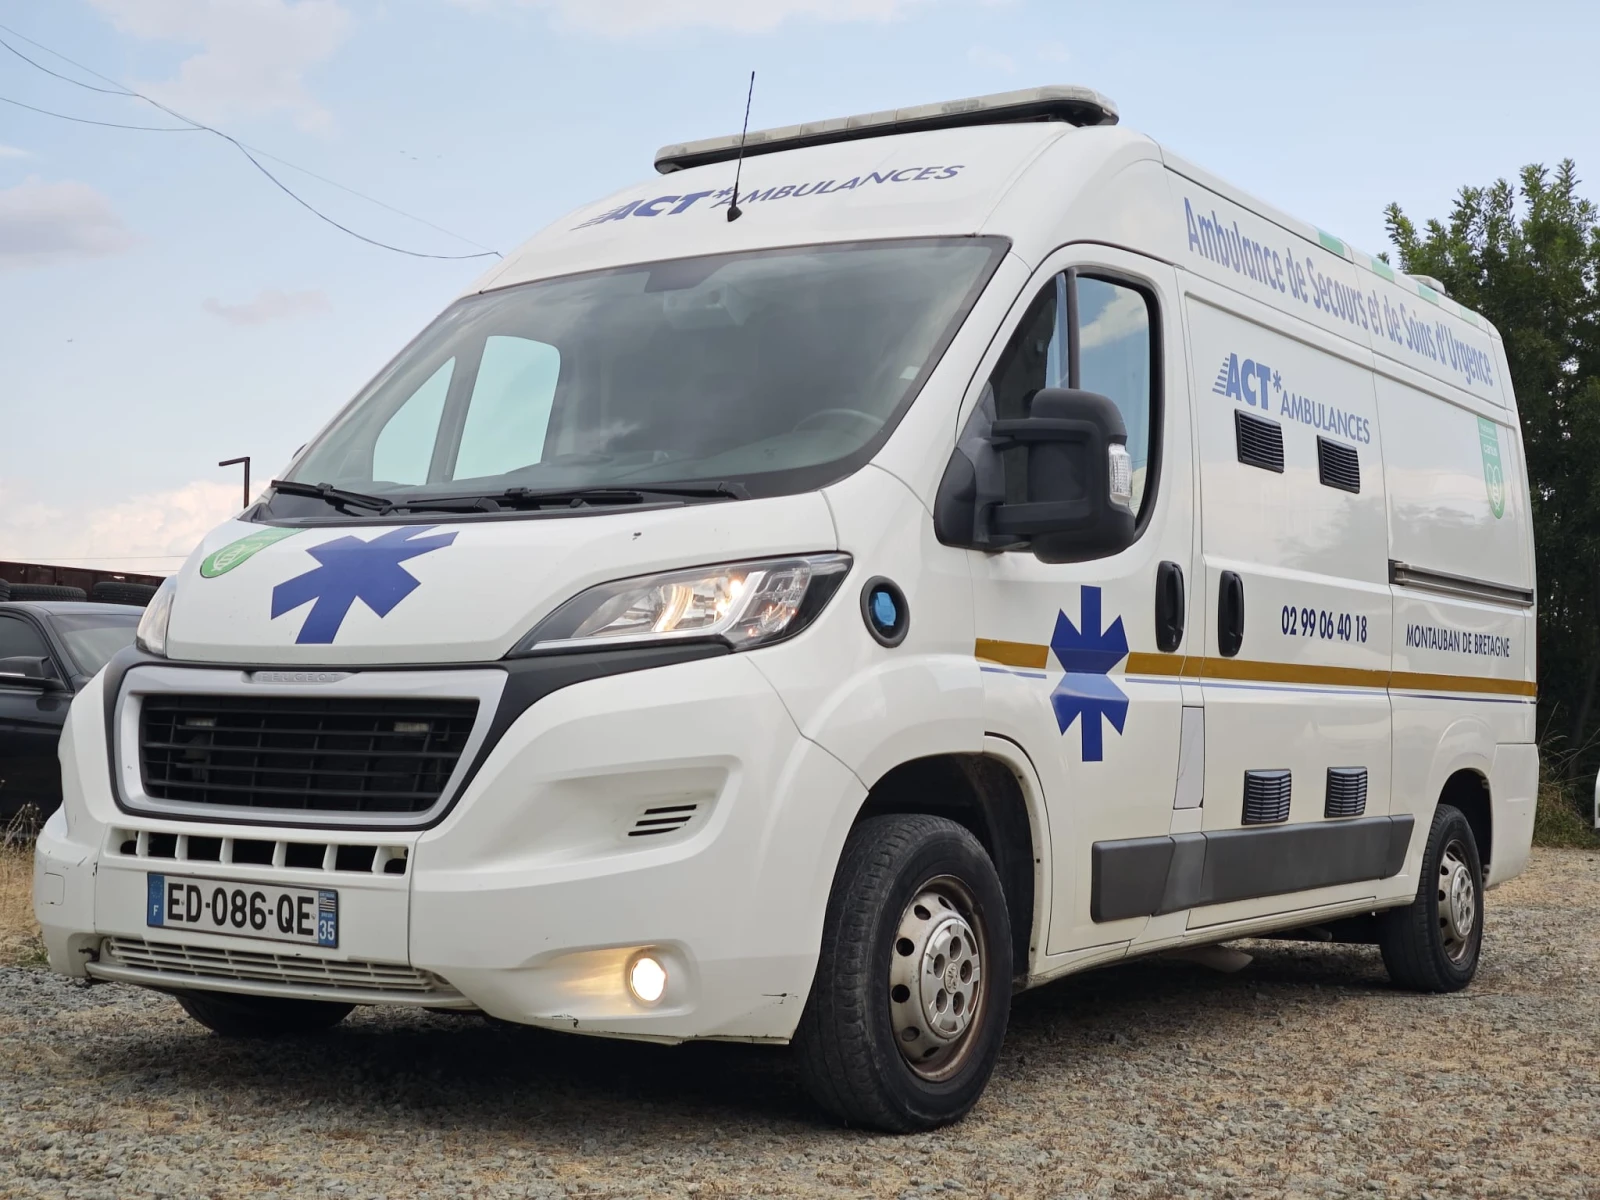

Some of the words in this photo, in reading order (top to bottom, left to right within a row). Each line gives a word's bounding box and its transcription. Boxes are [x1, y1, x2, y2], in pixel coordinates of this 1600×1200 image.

[711, 165, 965, 209] AMBULANCES
[1184, 197, 1286, 294] Ambulance
[1286, 248, 1308, 304] de
[1306, 257, 1369, 330] Secours
[1367, 290, 1384, 336] et
[1384, 295, 1403, 346] de
[1400, 303, 1437, 361] Soins
[1435, 320, 1494, 387] d'Urgence
[1280, 390, 1371, 445] AMBULANCES
[1281, 605, 1297, 636] 02
[1301, 607, 1316, 637] 99
[1319, 610, 1334, 640] 06
[1337, 613, 1352, 642] 40
[1355, 615, 1368, 643] 18
[1406, 624, 1461, 653] MONTAUBAN
[1461, 632, 1472, 654] DE
[1473, 633, 1510, 658] BRETAGNE
[261, 672, 338, 682] PEUGEOT
[153, 904, 159, 917] F
[167, 882, 315, 936] ED-086-QE
[319, 920, 335, 941] 35
